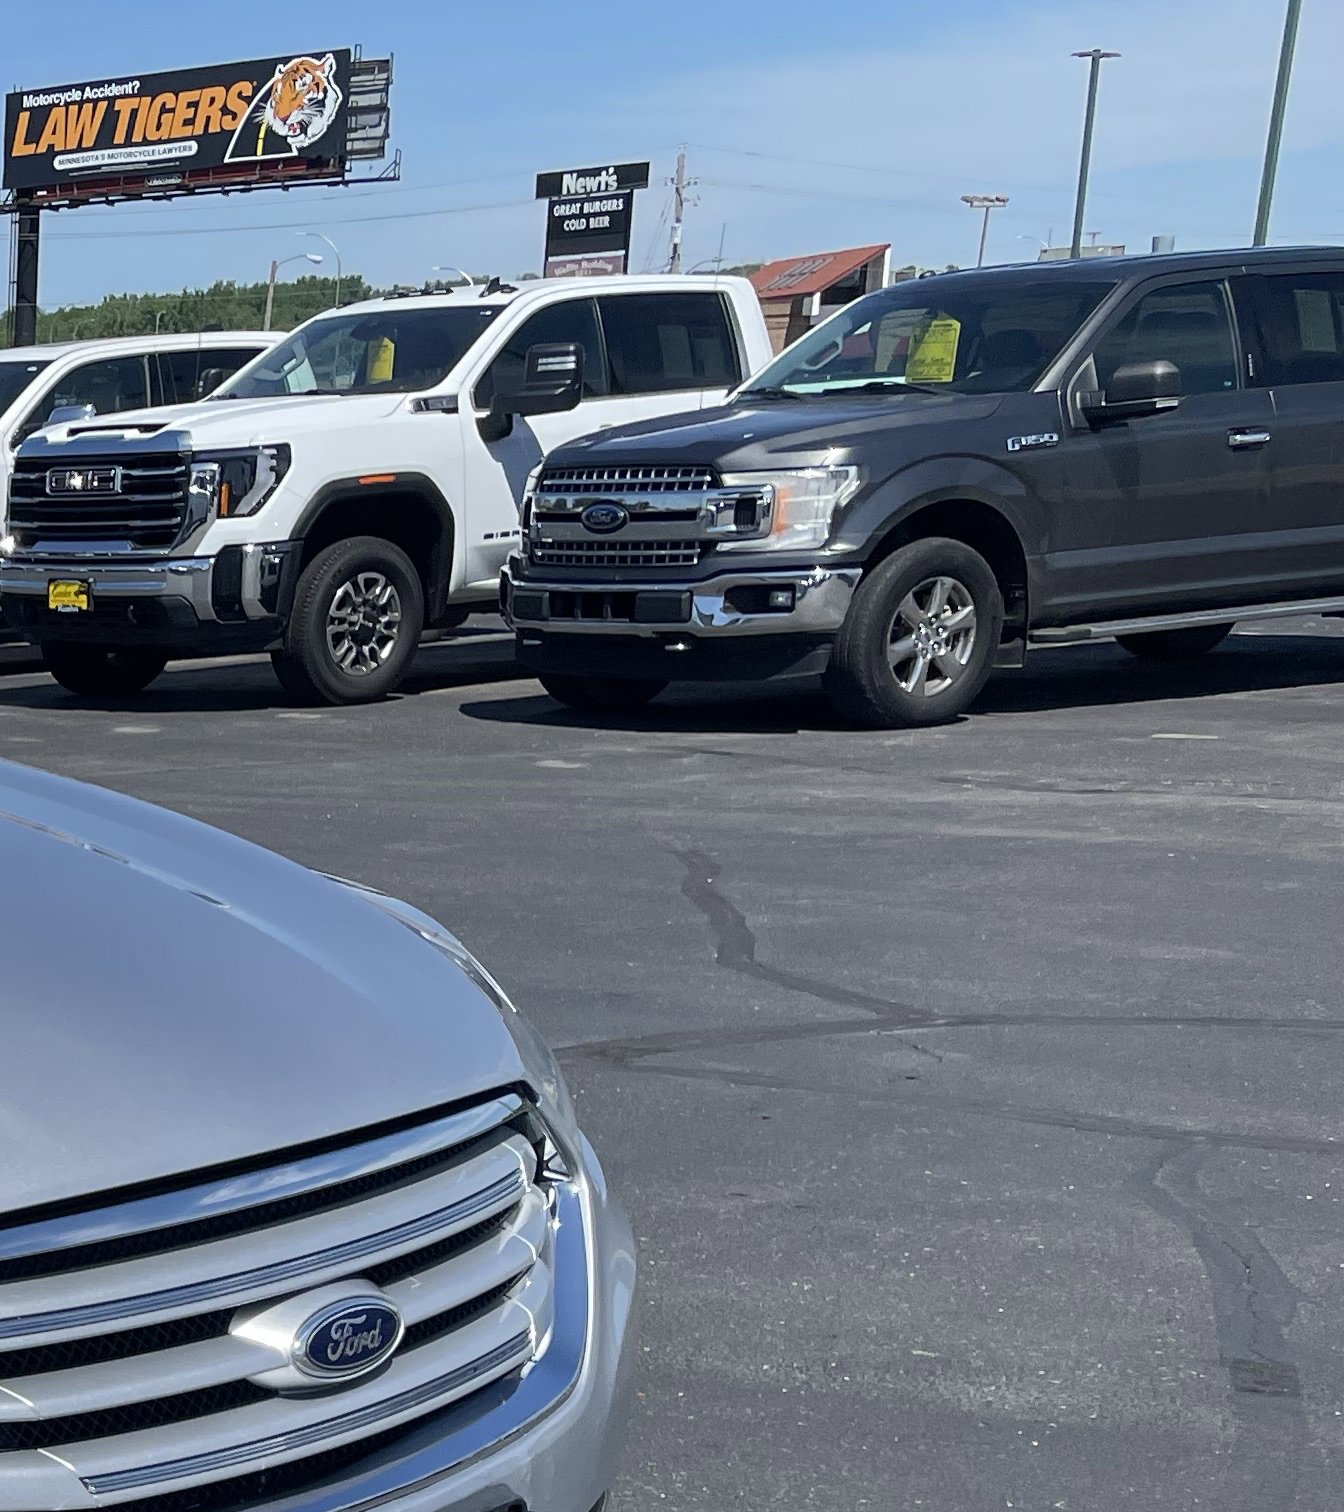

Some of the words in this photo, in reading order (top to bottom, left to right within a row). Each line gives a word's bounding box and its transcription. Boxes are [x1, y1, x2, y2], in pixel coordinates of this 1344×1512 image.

[22, 88, 82, 109] Motorcycle
[83, 81, 141, 102] Accident?
[11, 101, 108, 157] LAW
[113, 80, 253, 145] TIGERS
[58, 153, 106, 166] MINNESOTA'S
[107, 149, 156, 161] MOTORCYCLE
[157, 144, 193, 156] LAWYERS
[562, 167, 618, 195] Newt's
[553, 204, 581, 216] GREAT
[583, 198, 624, 214] BURGERS
[563, 218, 587, 232] COLD
[589, 215, 610, 229] BEER
[327, 1314, 383, 1362] Ford
